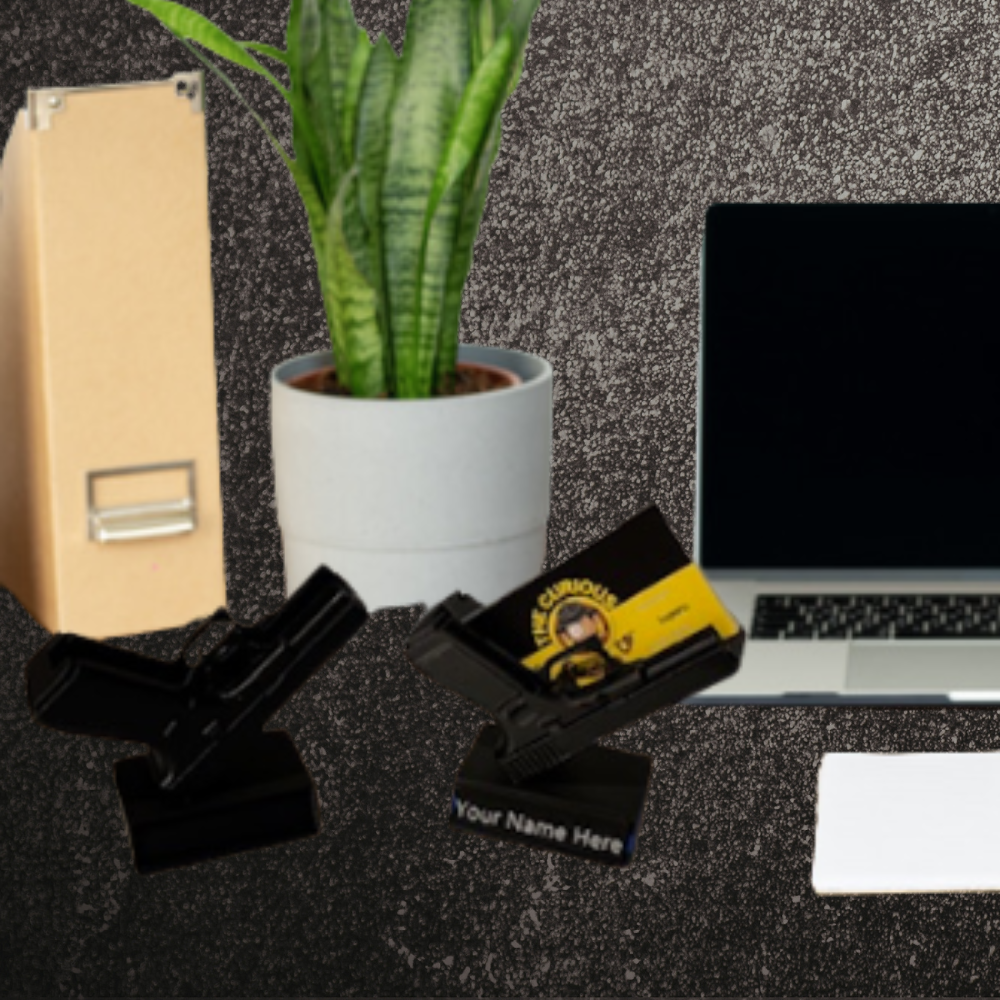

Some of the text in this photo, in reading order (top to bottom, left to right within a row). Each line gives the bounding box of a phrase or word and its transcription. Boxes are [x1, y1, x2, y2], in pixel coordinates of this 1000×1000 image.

[537, 578, 619, 611] CURIOUS
[456, 798, 625, 855] Your Name Here
